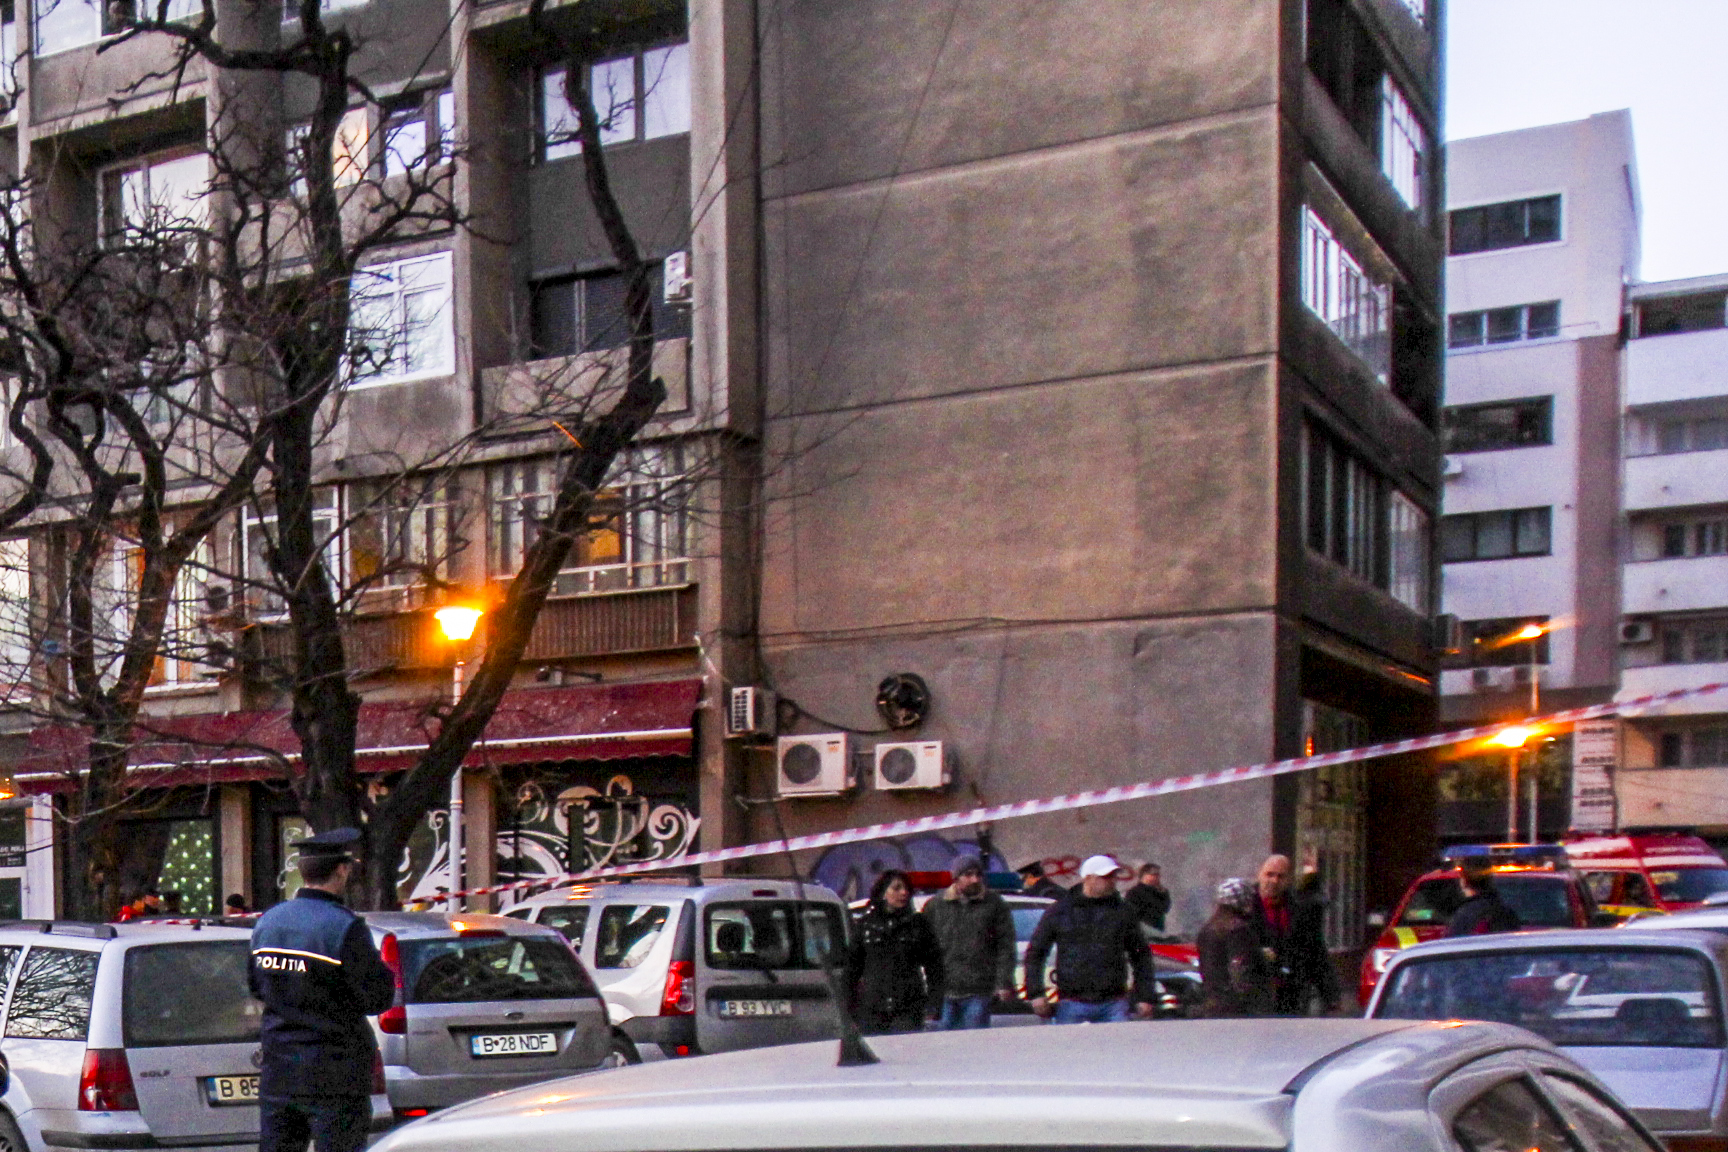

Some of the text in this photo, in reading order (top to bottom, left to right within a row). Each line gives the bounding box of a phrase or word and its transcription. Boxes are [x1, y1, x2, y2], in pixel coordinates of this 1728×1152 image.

[256, 956, 308, 972] POLITIA
[482, 1034, 550, 1053] B 28 NDF
[220, 1079, 234, 1098] B
